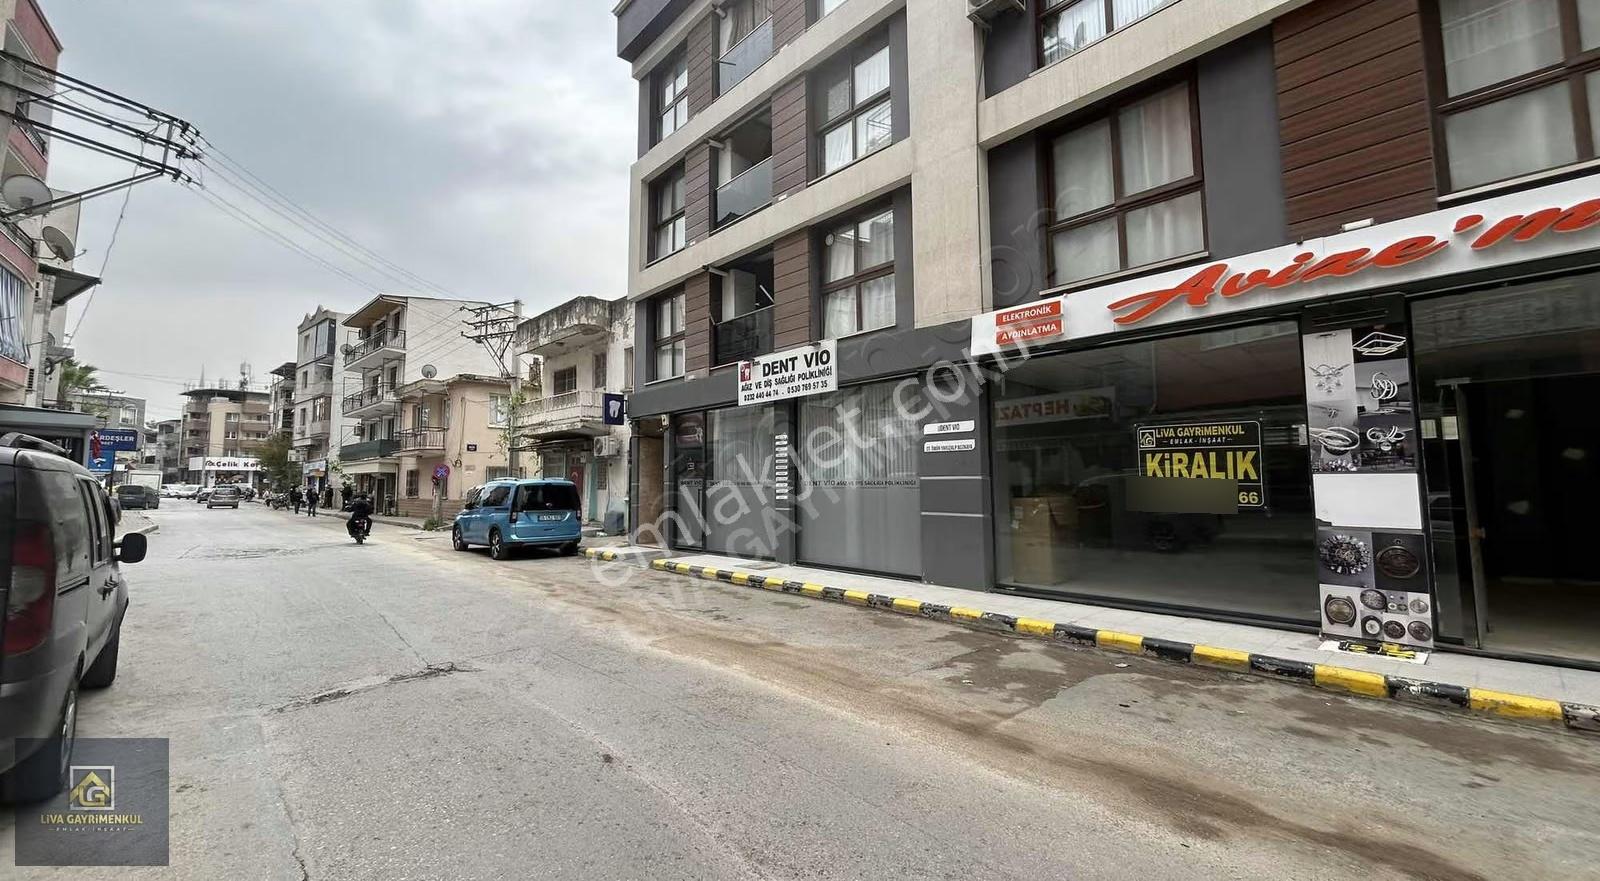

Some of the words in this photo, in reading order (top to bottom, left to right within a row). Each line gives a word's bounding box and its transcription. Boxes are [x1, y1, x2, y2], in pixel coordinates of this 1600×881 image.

[1003, 305, 1052, 322] ELEKTRONİK
[1002, 323, 1057, 340] AYDINLATMA
[762, 357, 798, 377] DENT
[804, 349, 831, 368] VIO
[741, 383, 752, 391] AĞIZ
[755, 381, 763, 389] VE
[764, 378, 772, 389] DİŞ
[775, 373, 796, 386] SAĞLIĞI
[798, 365, 833, 381] POLİKLİNİĞİ
[744, 393, 755, 401] 0232
[802, 382, 812, 391] 769
[813, 381, 820, 389] 57
[821, 379, 828, 388] 35
[90, 434, 135, 442] KRDEŞLER
[1239, 491, 1259, 504] 66
